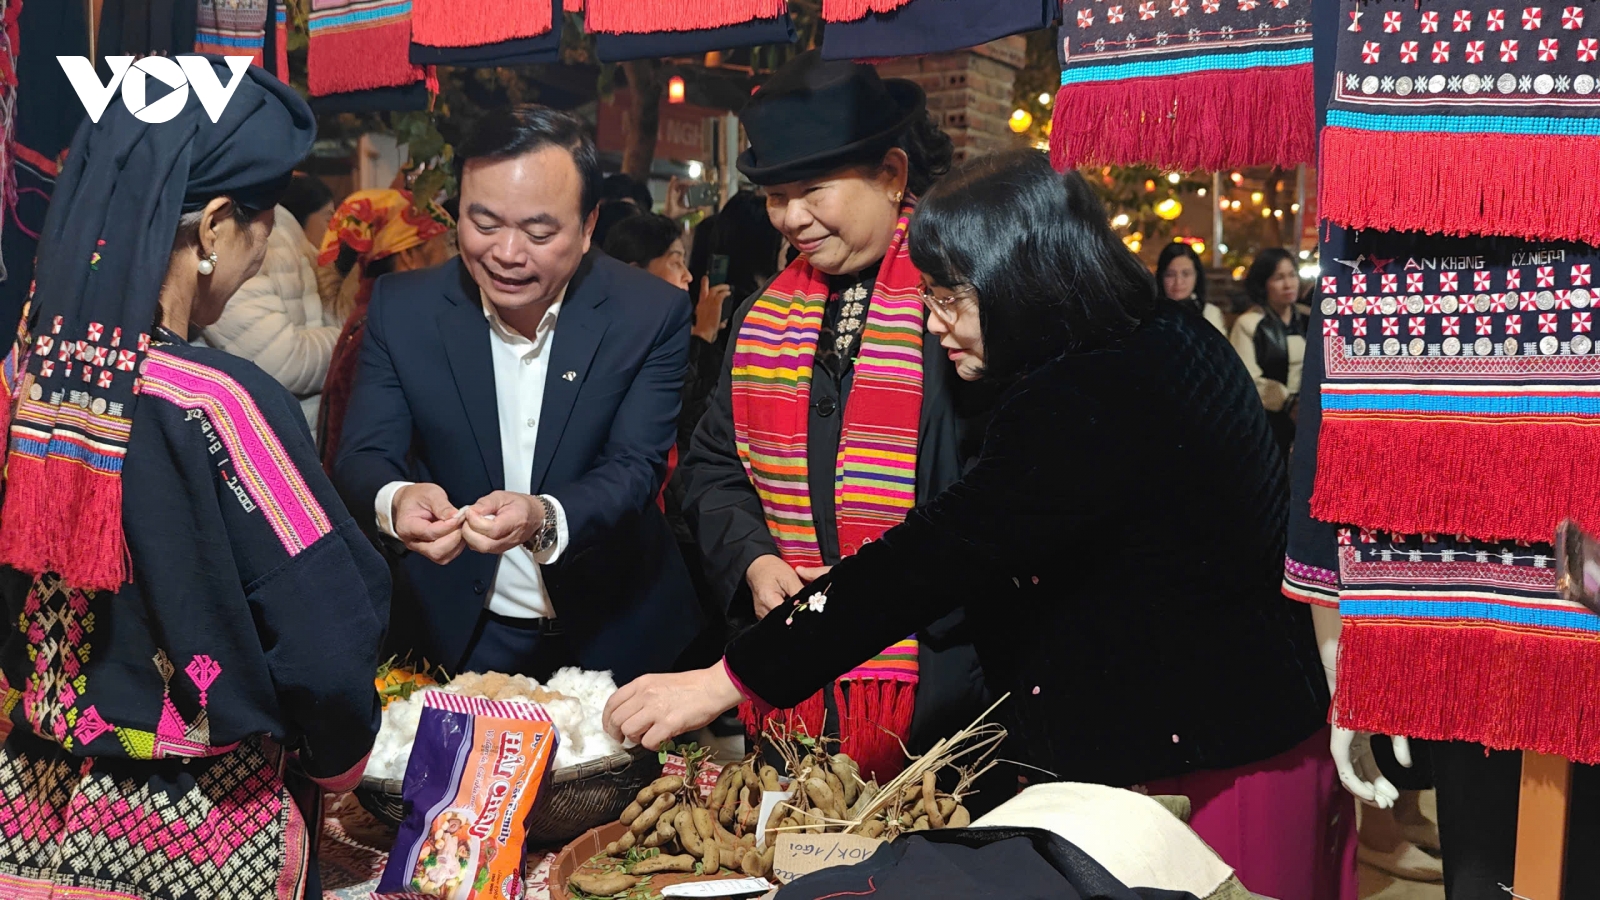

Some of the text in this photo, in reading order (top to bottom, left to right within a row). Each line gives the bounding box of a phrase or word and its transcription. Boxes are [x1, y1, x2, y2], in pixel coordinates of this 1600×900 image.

[1403, 257, 1437, 271] AN
[468, 730, 525, 839] HẢI CHÂU
